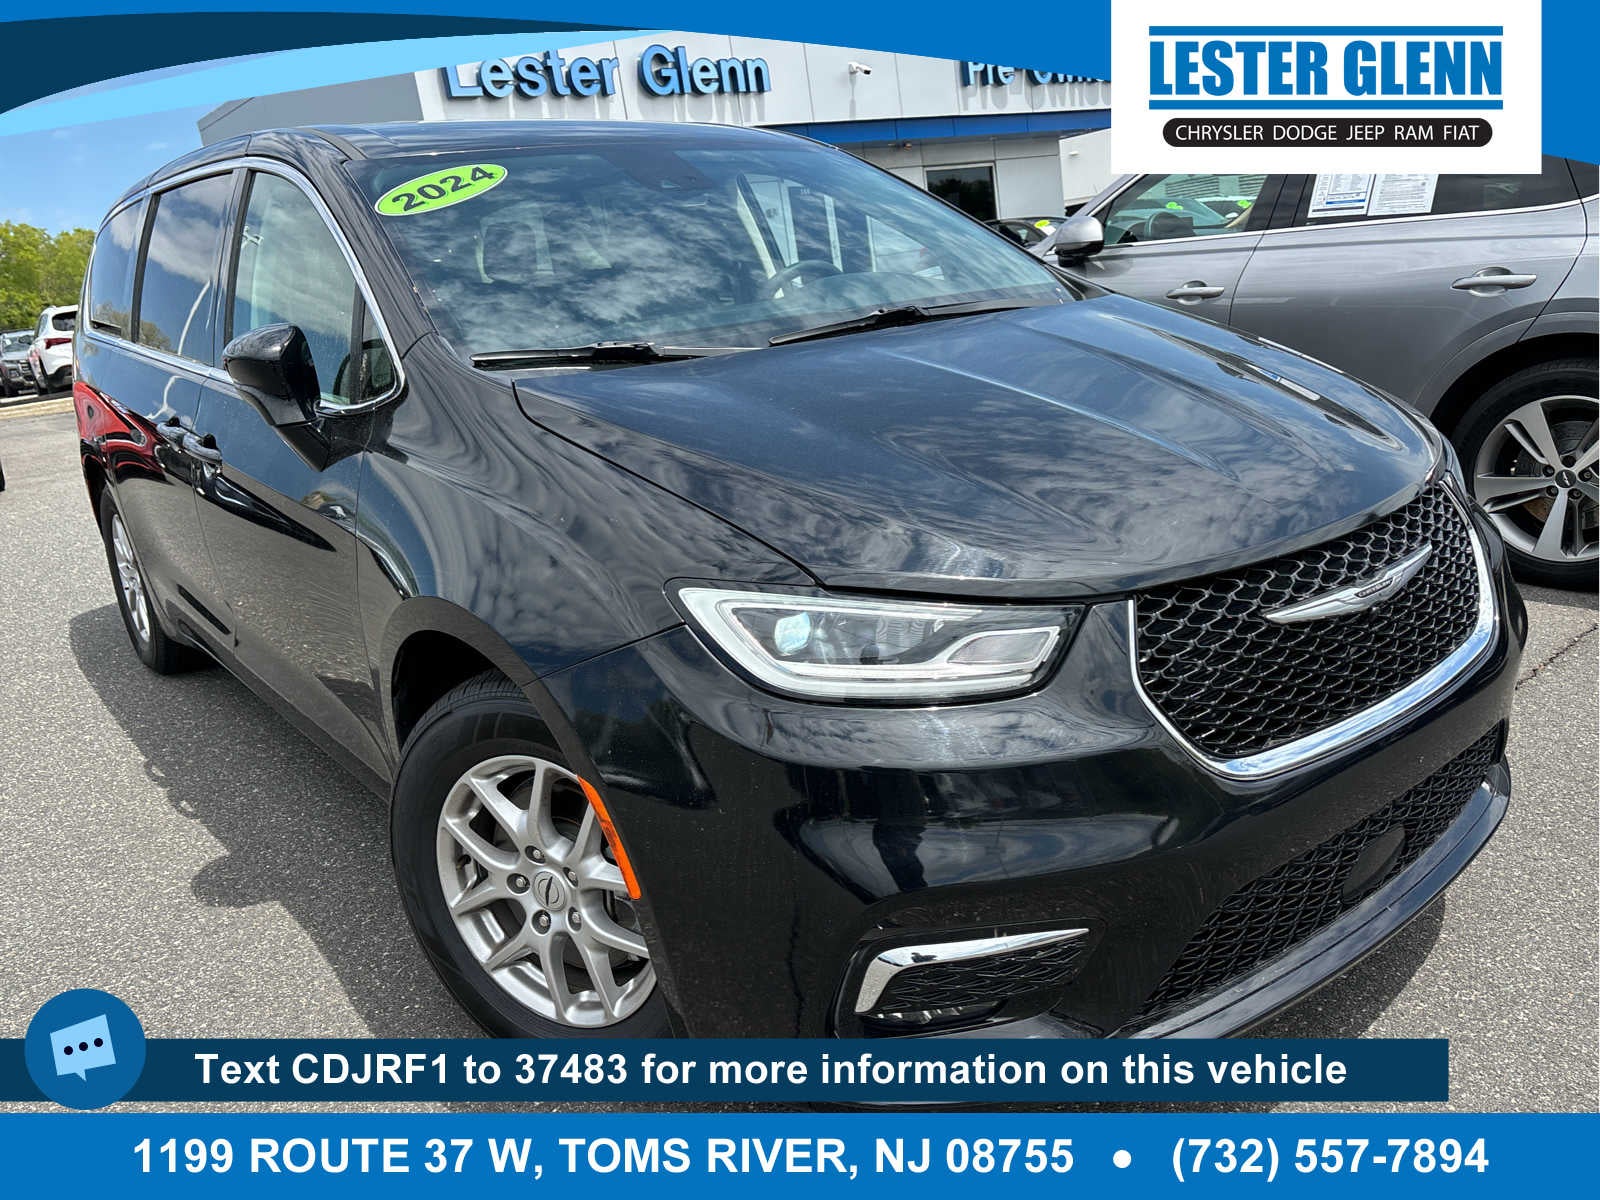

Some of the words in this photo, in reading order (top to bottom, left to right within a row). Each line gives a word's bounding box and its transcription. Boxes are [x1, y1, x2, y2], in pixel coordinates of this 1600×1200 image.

[440, 50, 619, 98] Lester
[638, 44, 772, 96] Glenn
[391, 166, 496, 212] 2024
